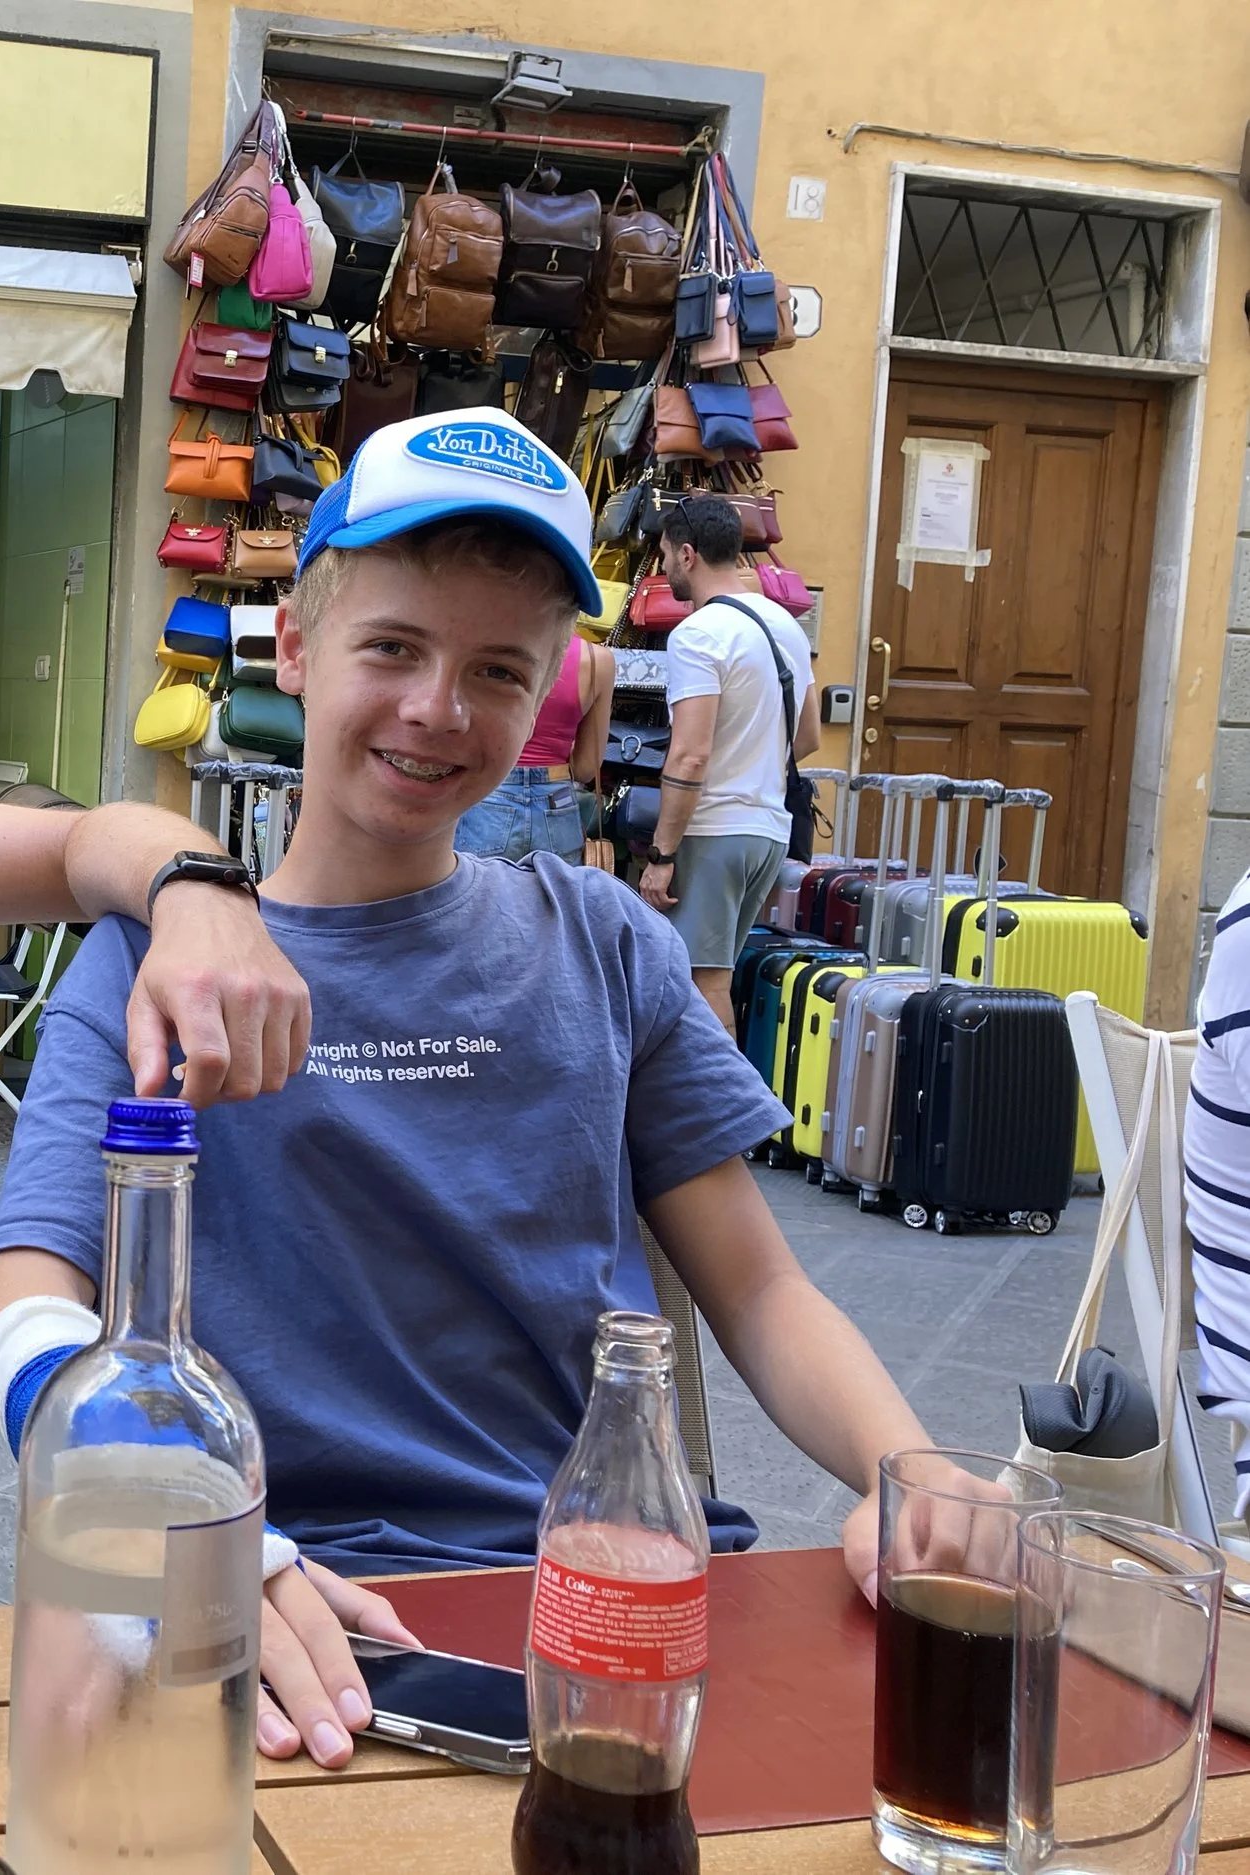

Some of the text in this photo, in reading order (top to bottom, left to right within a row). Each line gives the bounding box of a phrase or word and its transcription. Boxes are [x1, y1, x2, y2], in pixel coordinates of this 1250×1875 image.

[427, 427, 554, 484] Von Dutch
[462, 459, 524, 480] ORIGINALS
[381, 1040, 415, 1058] Not
[419, 1038, 452, 1055] For
[456, 1036, 502, 1053] Sale.
[306, 1060, 475, 1083] All rights reserved.
[565, 1576, 596, 1595] Coke
